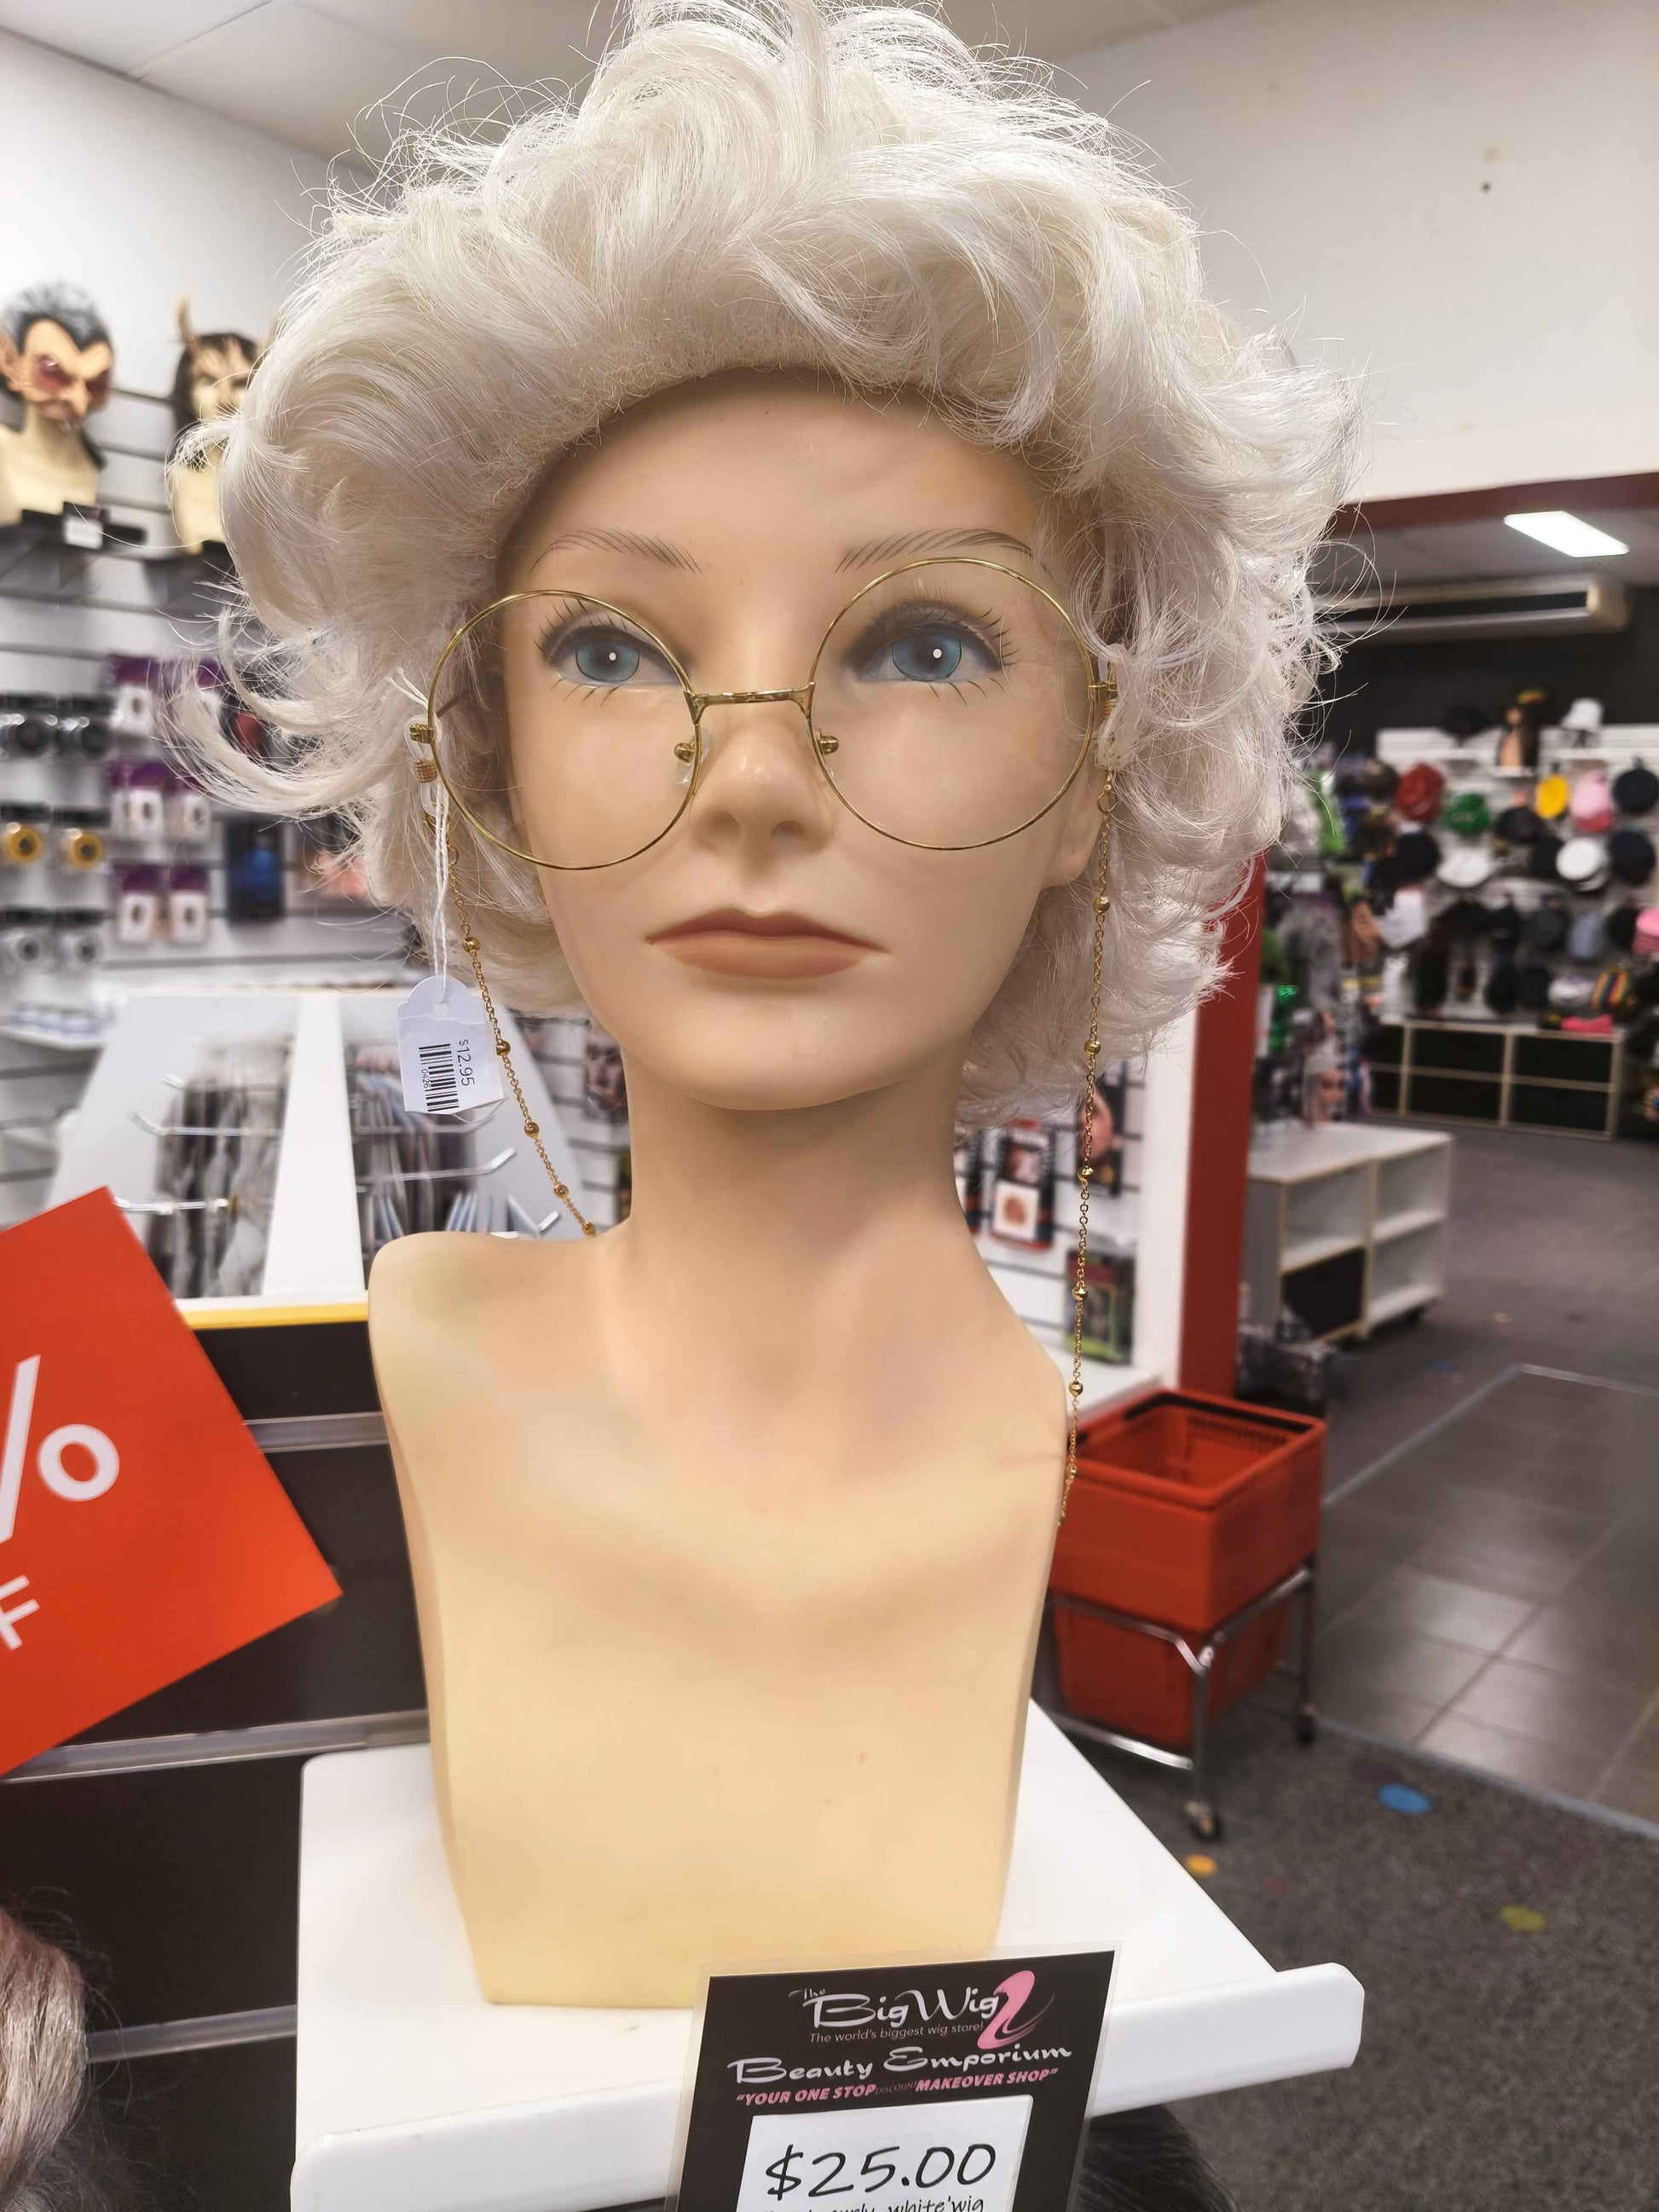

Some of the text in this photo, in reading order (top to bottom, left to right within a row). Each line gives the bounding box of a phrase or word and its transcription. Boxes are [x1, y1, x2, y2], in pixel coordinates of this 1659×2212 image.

[421, 1069, 431, 1089] 0426
[457, 1039, 475, 1086] $12.95
[810, 2020, 984, 2043] The world's biggest wig store!
[727, 2043, 1072, 2084] Beauty Emporium
[736, 2091, 791, 2106] "YOUR
[795, 2088, 830, 2102] ONE
[833, 2083, 877, 2099] STOP
[915, 2073, 1004, 2092] MAKEOVER
[1006, 2068, 1059, 2084] SHOP"
[766, 2144, 996, 2201] $25.00
